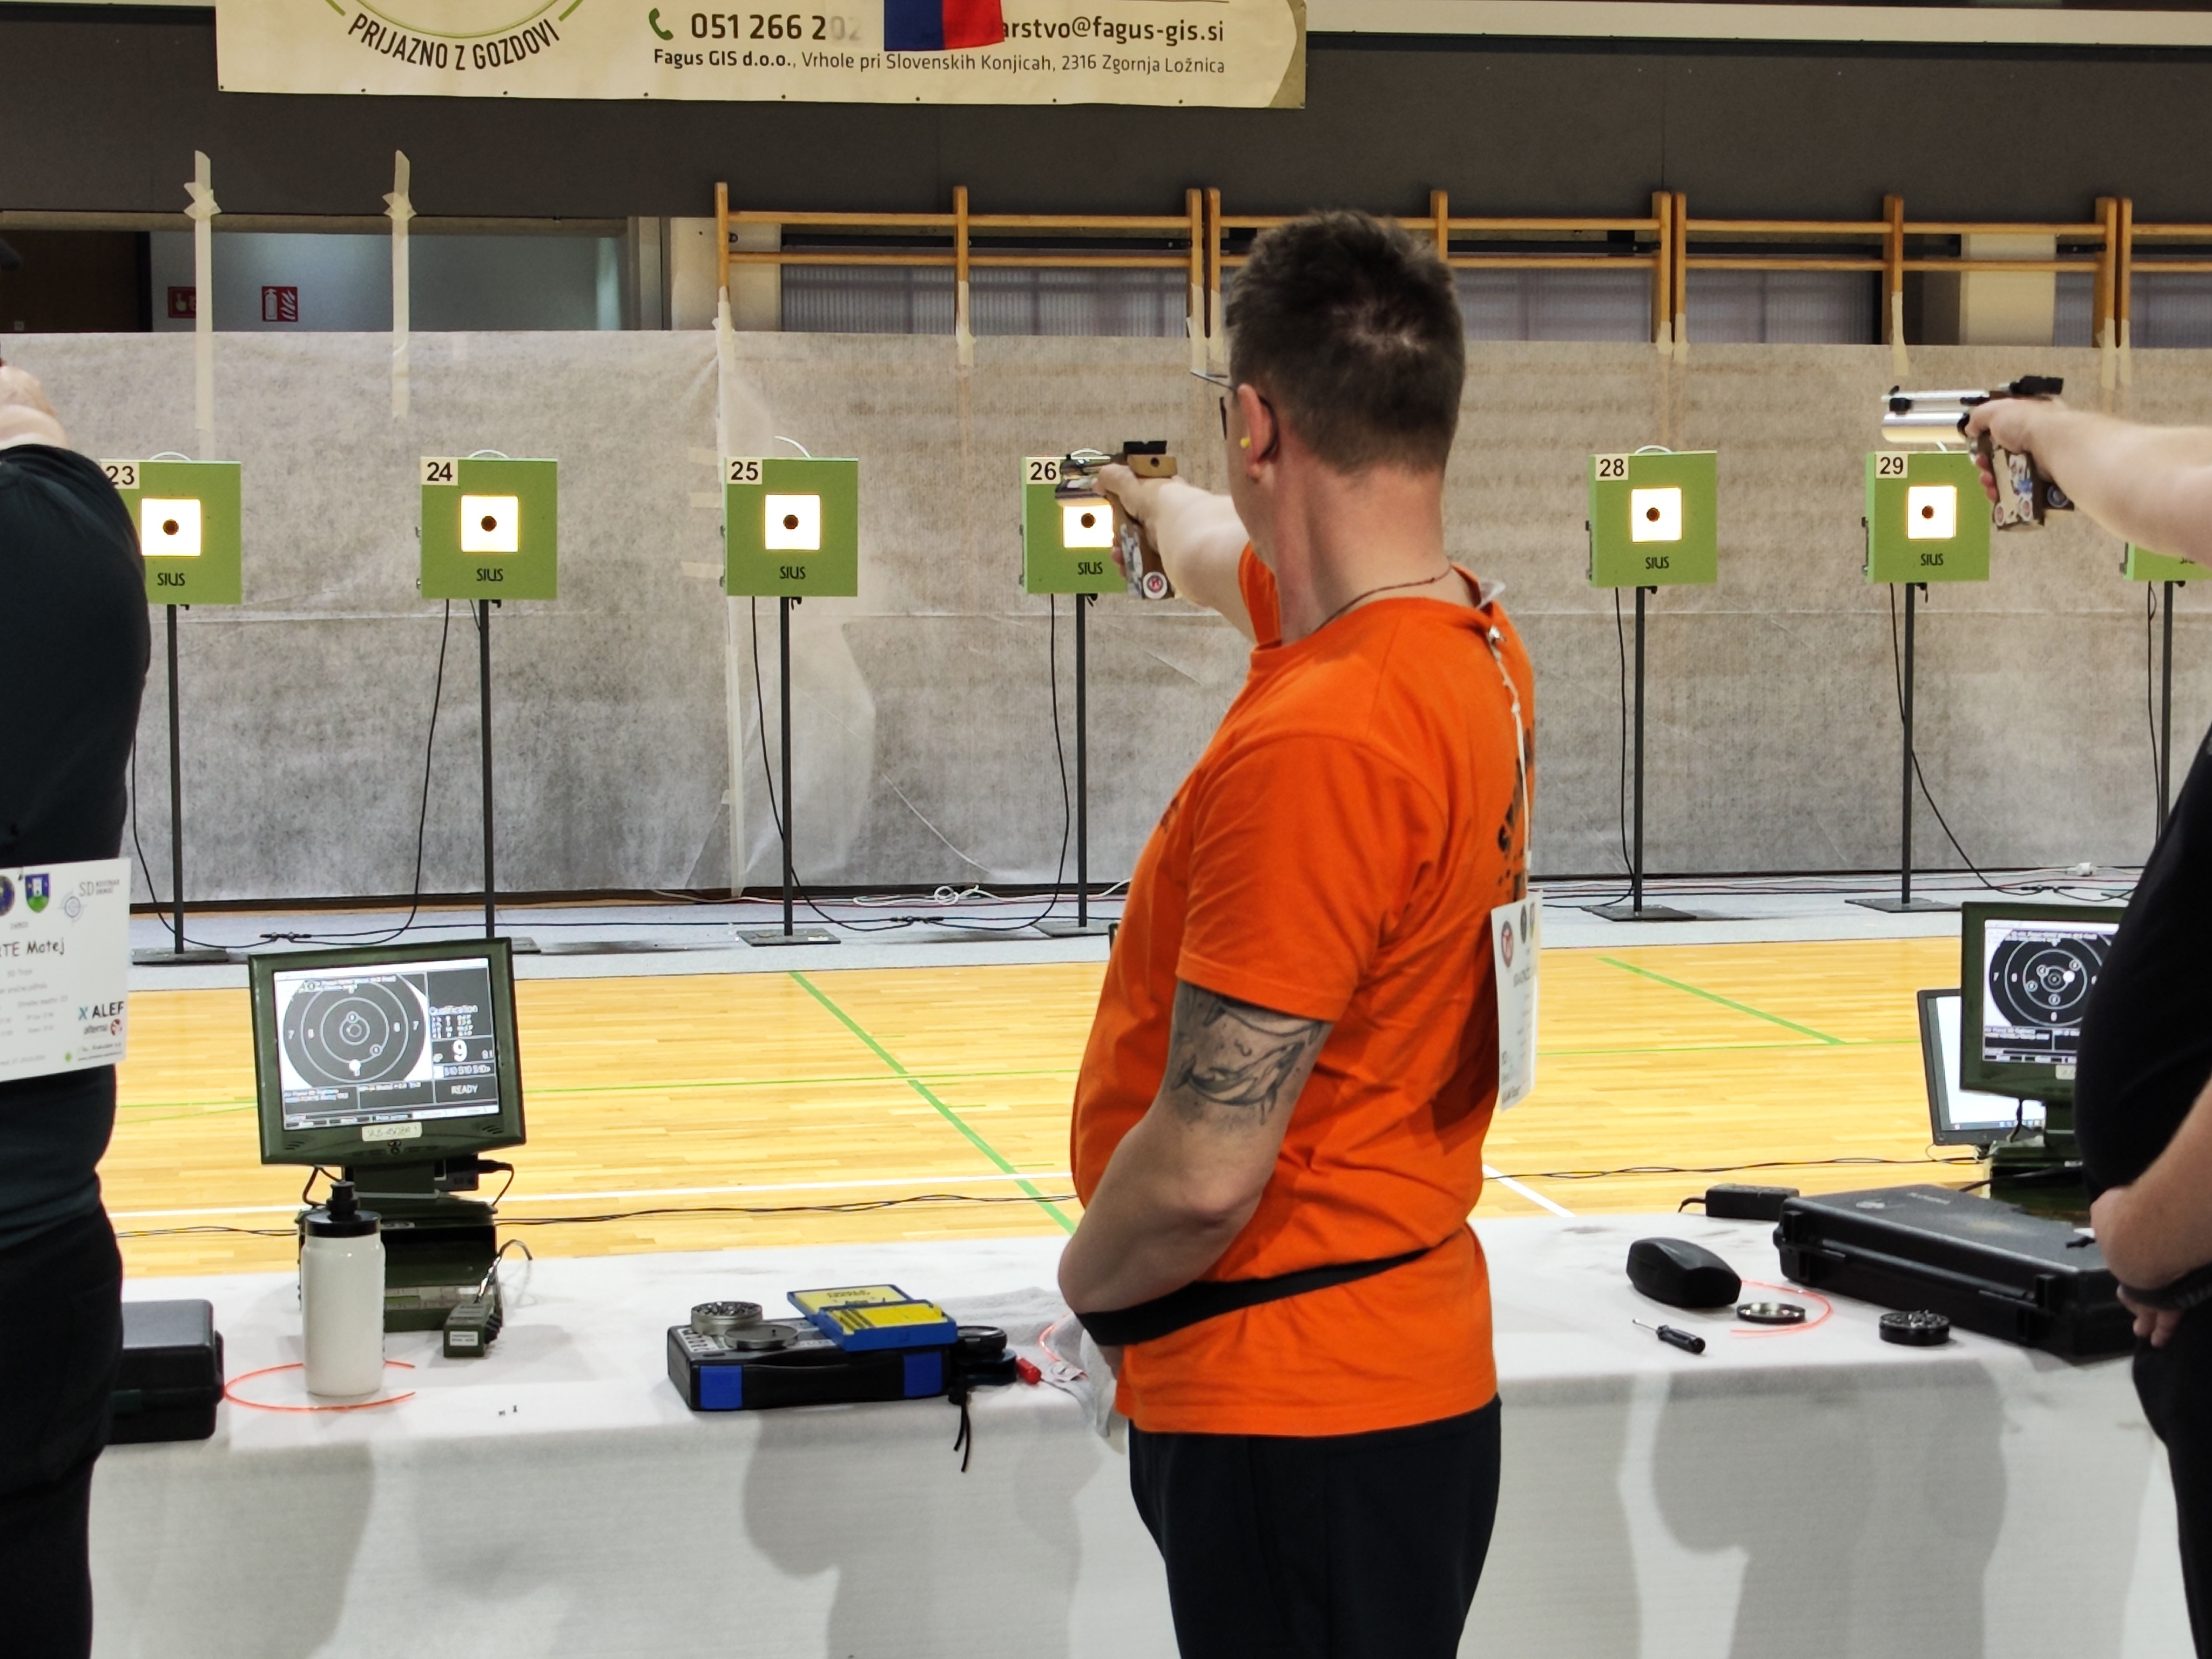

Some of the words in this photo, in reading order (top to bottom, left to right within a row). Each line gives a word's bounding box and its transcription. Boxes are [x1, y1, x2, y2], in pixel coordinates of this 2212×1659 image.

[691, 12, 739, 39] 051
[749, 14, 802, 39] 266
[1002, 16, 1224, 47] arstvo@fagus-gis.si
[347, 12, 448, 69] PRIJAZNO
[455, 45, 466, 71] Z
[472, 18, 560, 70] GOZDOVI
[654, 49, 704, 69] Fagus
[709, 50, 738, 66] GIS
[742, 51, 797, 69] d.o.o.,
[801, 51, 854, 69] Vrhole
[860, 52, 881, 72] pri
[886, 53, 976, 70] Slovenskih
[981, 55, 1056, 74] Konjicah,
[1061, 55, 1097, 71] 2316
[1102, 55, 1161, 75] Zgornja
[1165, 56, 1225, 73] Ložnica
[105, 465, 135, 485] 23
[426, 462, 453, 482] 24
[730, 461, 759, 481] 25
[1029, 461, 1057, 481] 26
[1599, 458, 1625, 477] 28
[1879, 456, 1904, 475] 29
[1077, 561, 1103, 575] SIUS
[1644, 556, 1670, 570] SIUS
[1920, 552, 1944, 566] SIUS
[157, 572, 186, 586] SIUS
[476, 568, 504, 582] SIUS
[779, 565, 806, 580] SIUS
[0, 941, 21, 957] TE
[26, 936, 65, 956] Matej
[92, 1001, 125, 1019] ALEF
[454, 1039, 468, 1062] 9
